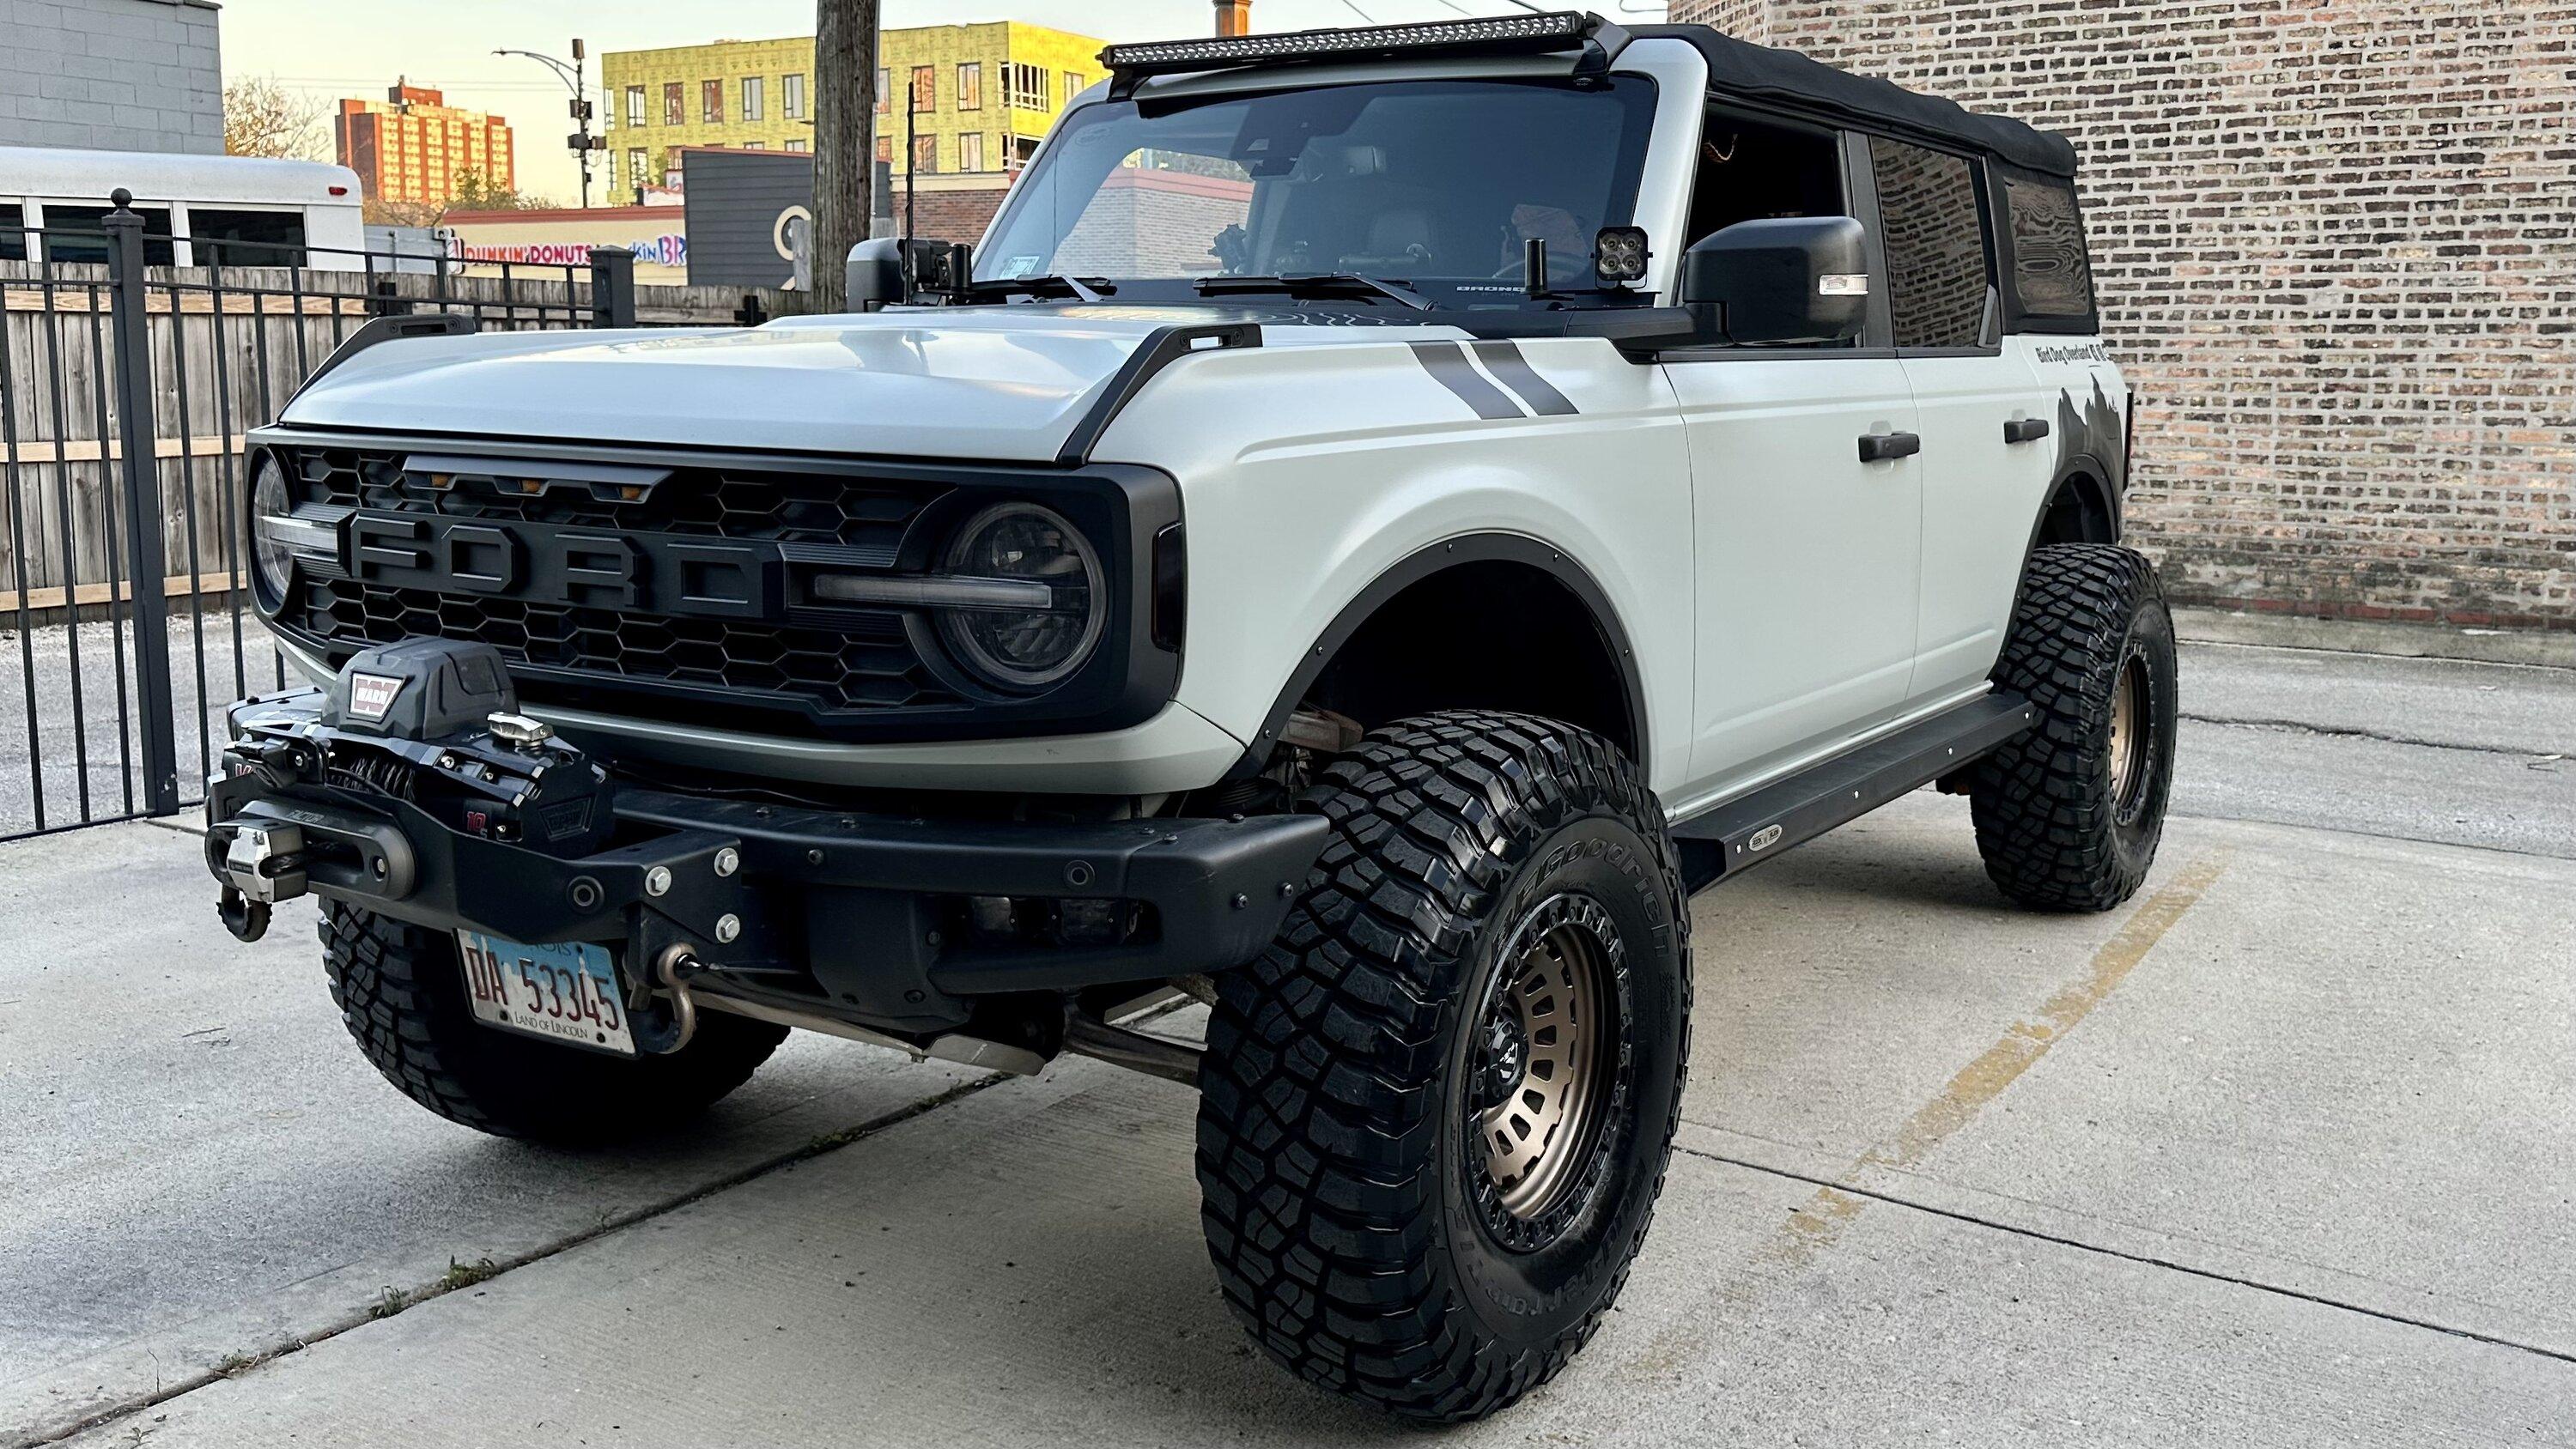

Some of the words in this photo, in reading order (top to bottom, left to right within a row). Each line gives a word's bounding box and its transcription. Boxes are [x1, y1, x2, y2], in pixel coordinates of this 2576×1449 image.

[529, 244, 592, 264] DONUTS
[350, 515, 763, 619] FORD
[355, 687, 389, 705] WARN
[466, 946, 508, 1006] DA
[518, 956, 620, 1031] 53345
